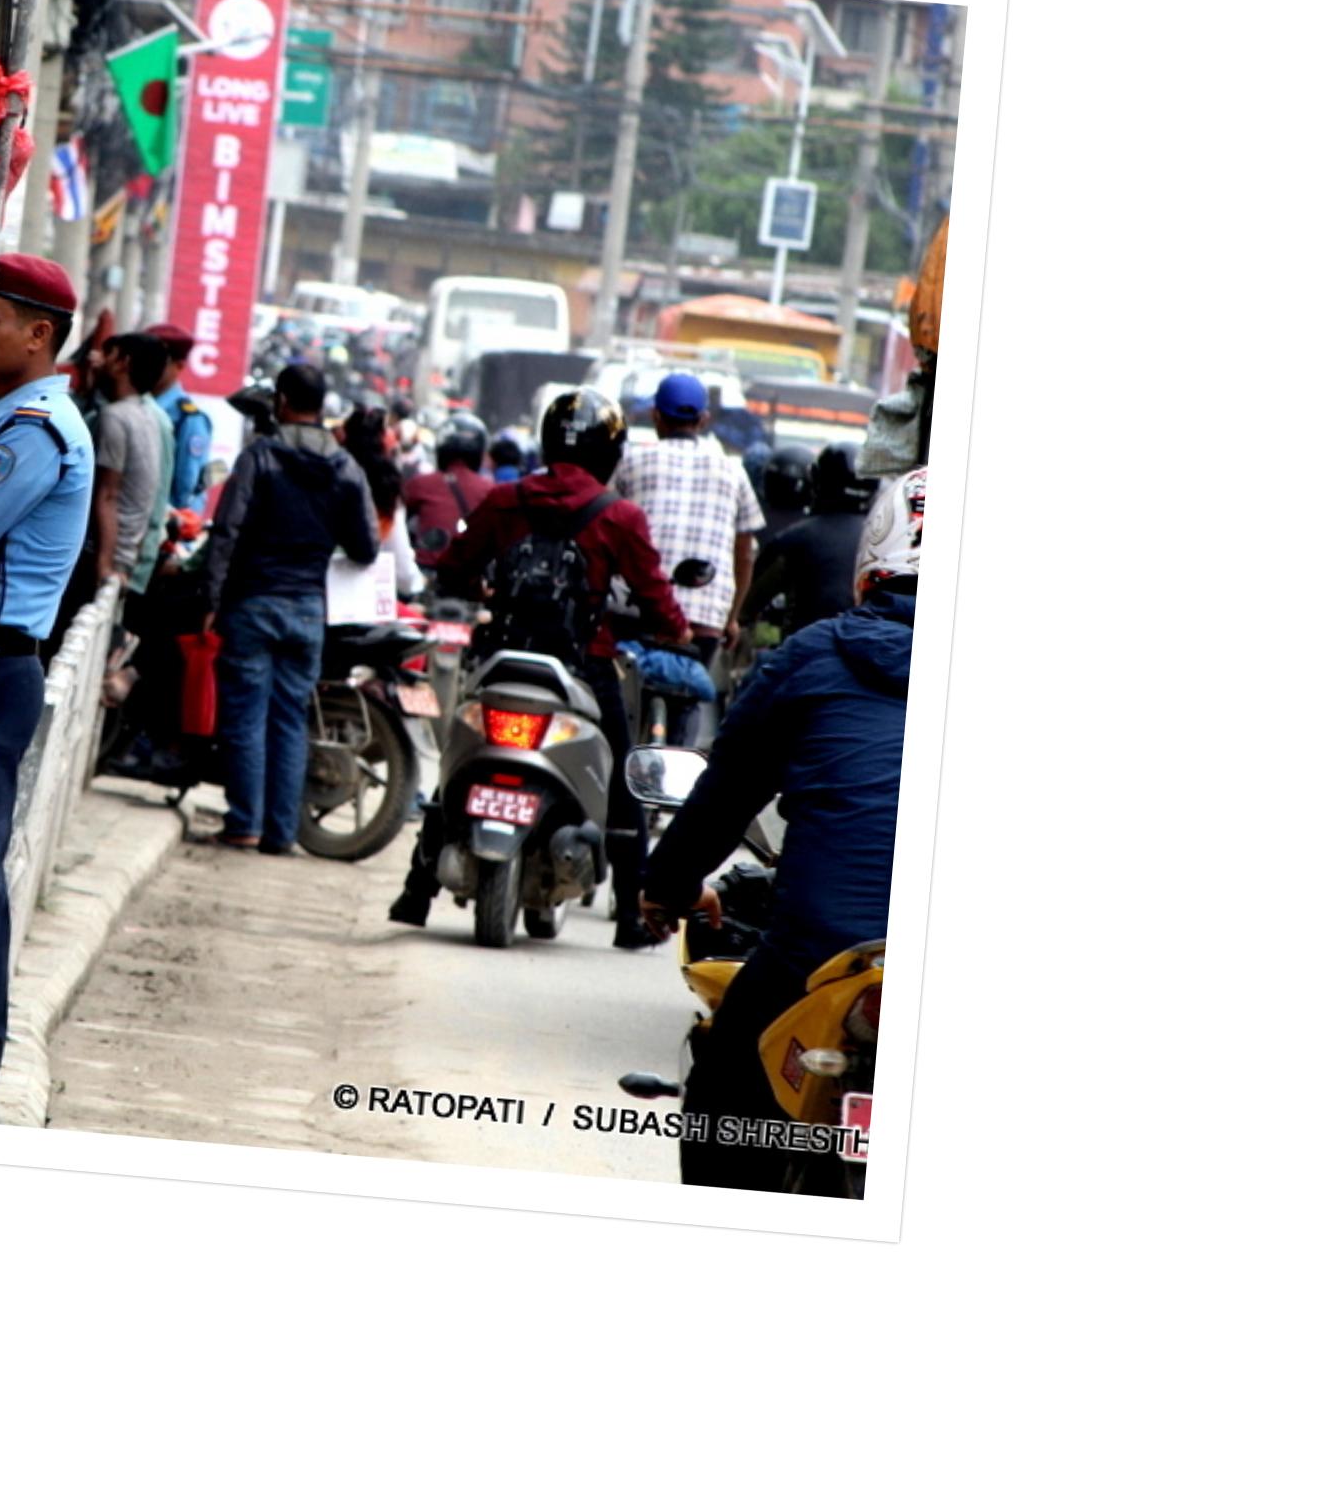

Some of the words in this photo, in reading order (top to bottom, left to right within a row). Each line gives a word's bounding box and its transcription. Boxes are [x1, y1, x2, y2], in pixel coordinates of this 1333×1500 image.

[197, 74, 270, 103] LONG
[201, 101, 260, 127] LIVE
[188, 133, 242, 379] BIMSTEC
